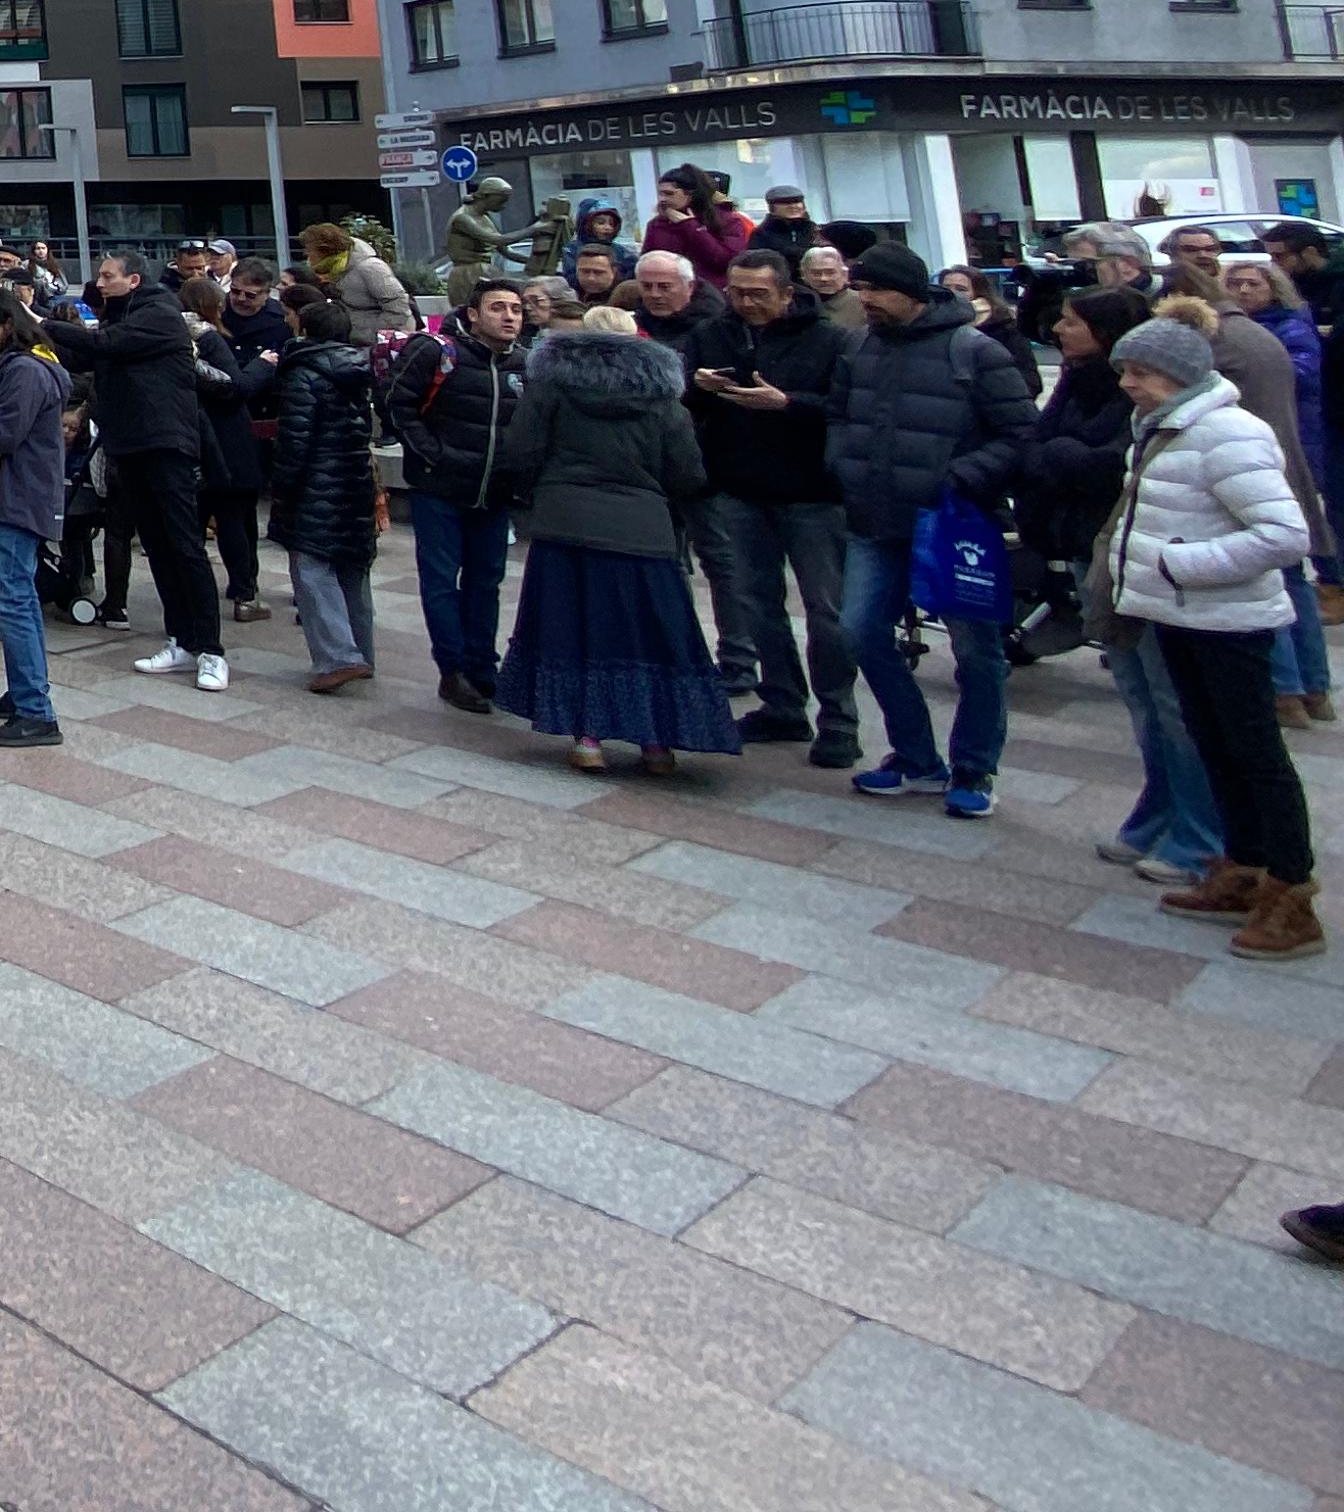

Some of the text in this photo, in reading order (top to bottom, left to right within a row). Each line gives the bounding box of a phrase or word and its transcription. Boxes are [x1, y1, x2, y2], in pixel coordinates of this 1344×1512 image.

[960, 90, 1295, 121] FARMÀCIA DE LES VALLS
[460, 102, 777, 152] FARMÀCIA DE LES VALLS
